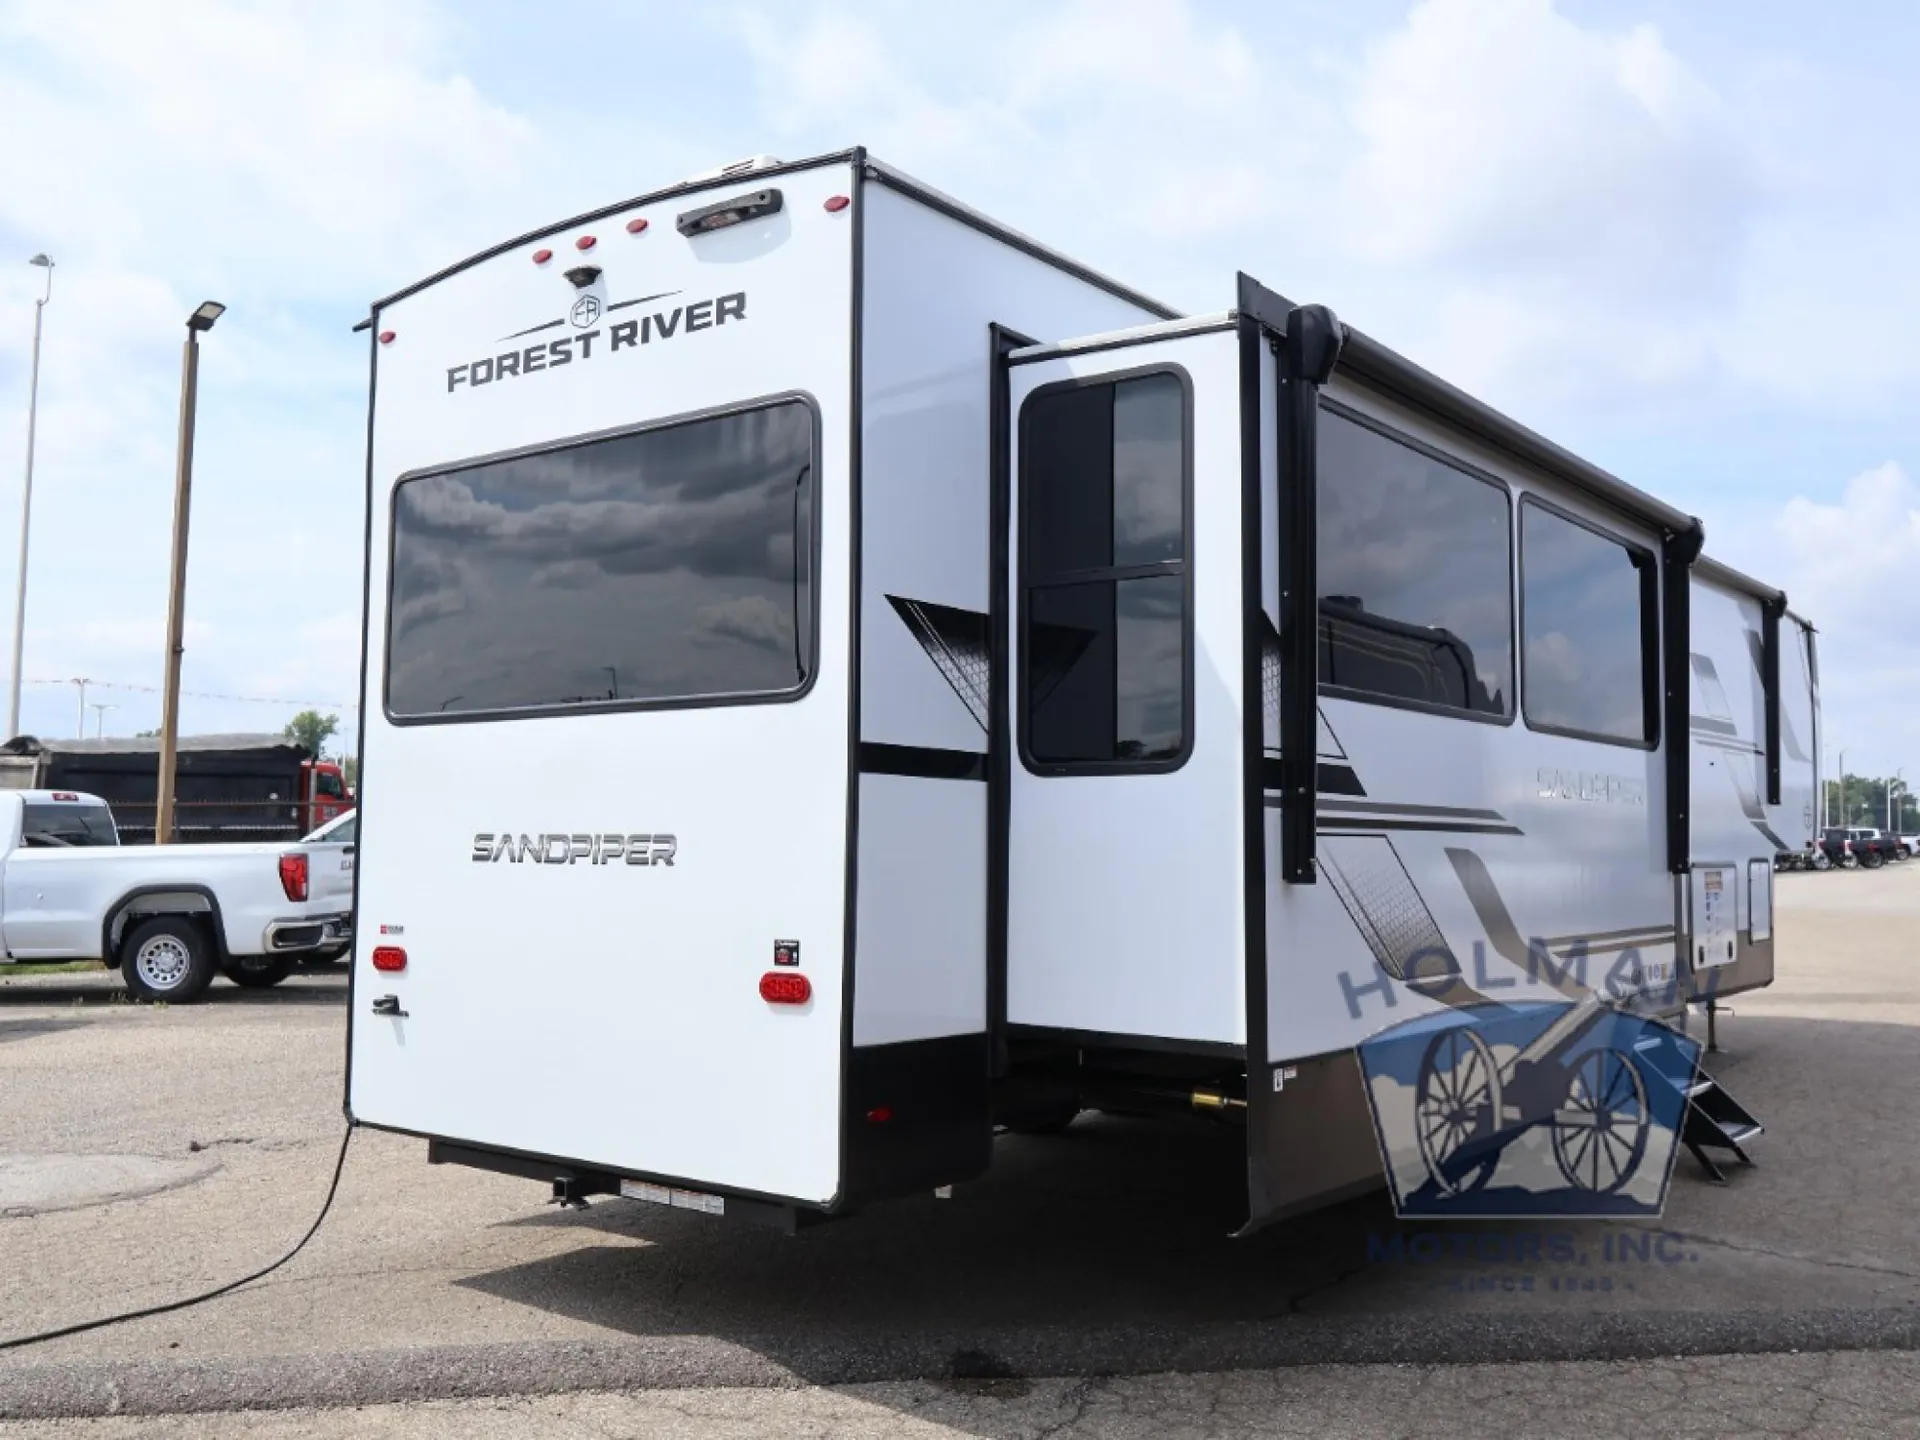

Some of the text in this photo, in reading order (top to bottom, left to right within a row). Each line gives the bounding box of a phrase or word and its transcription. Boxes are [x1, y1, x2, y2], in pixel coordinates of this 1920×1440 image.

[447, 291, 747, 393] FOREST RIVER
[472, 833, 677, 866] SANDPIPER
